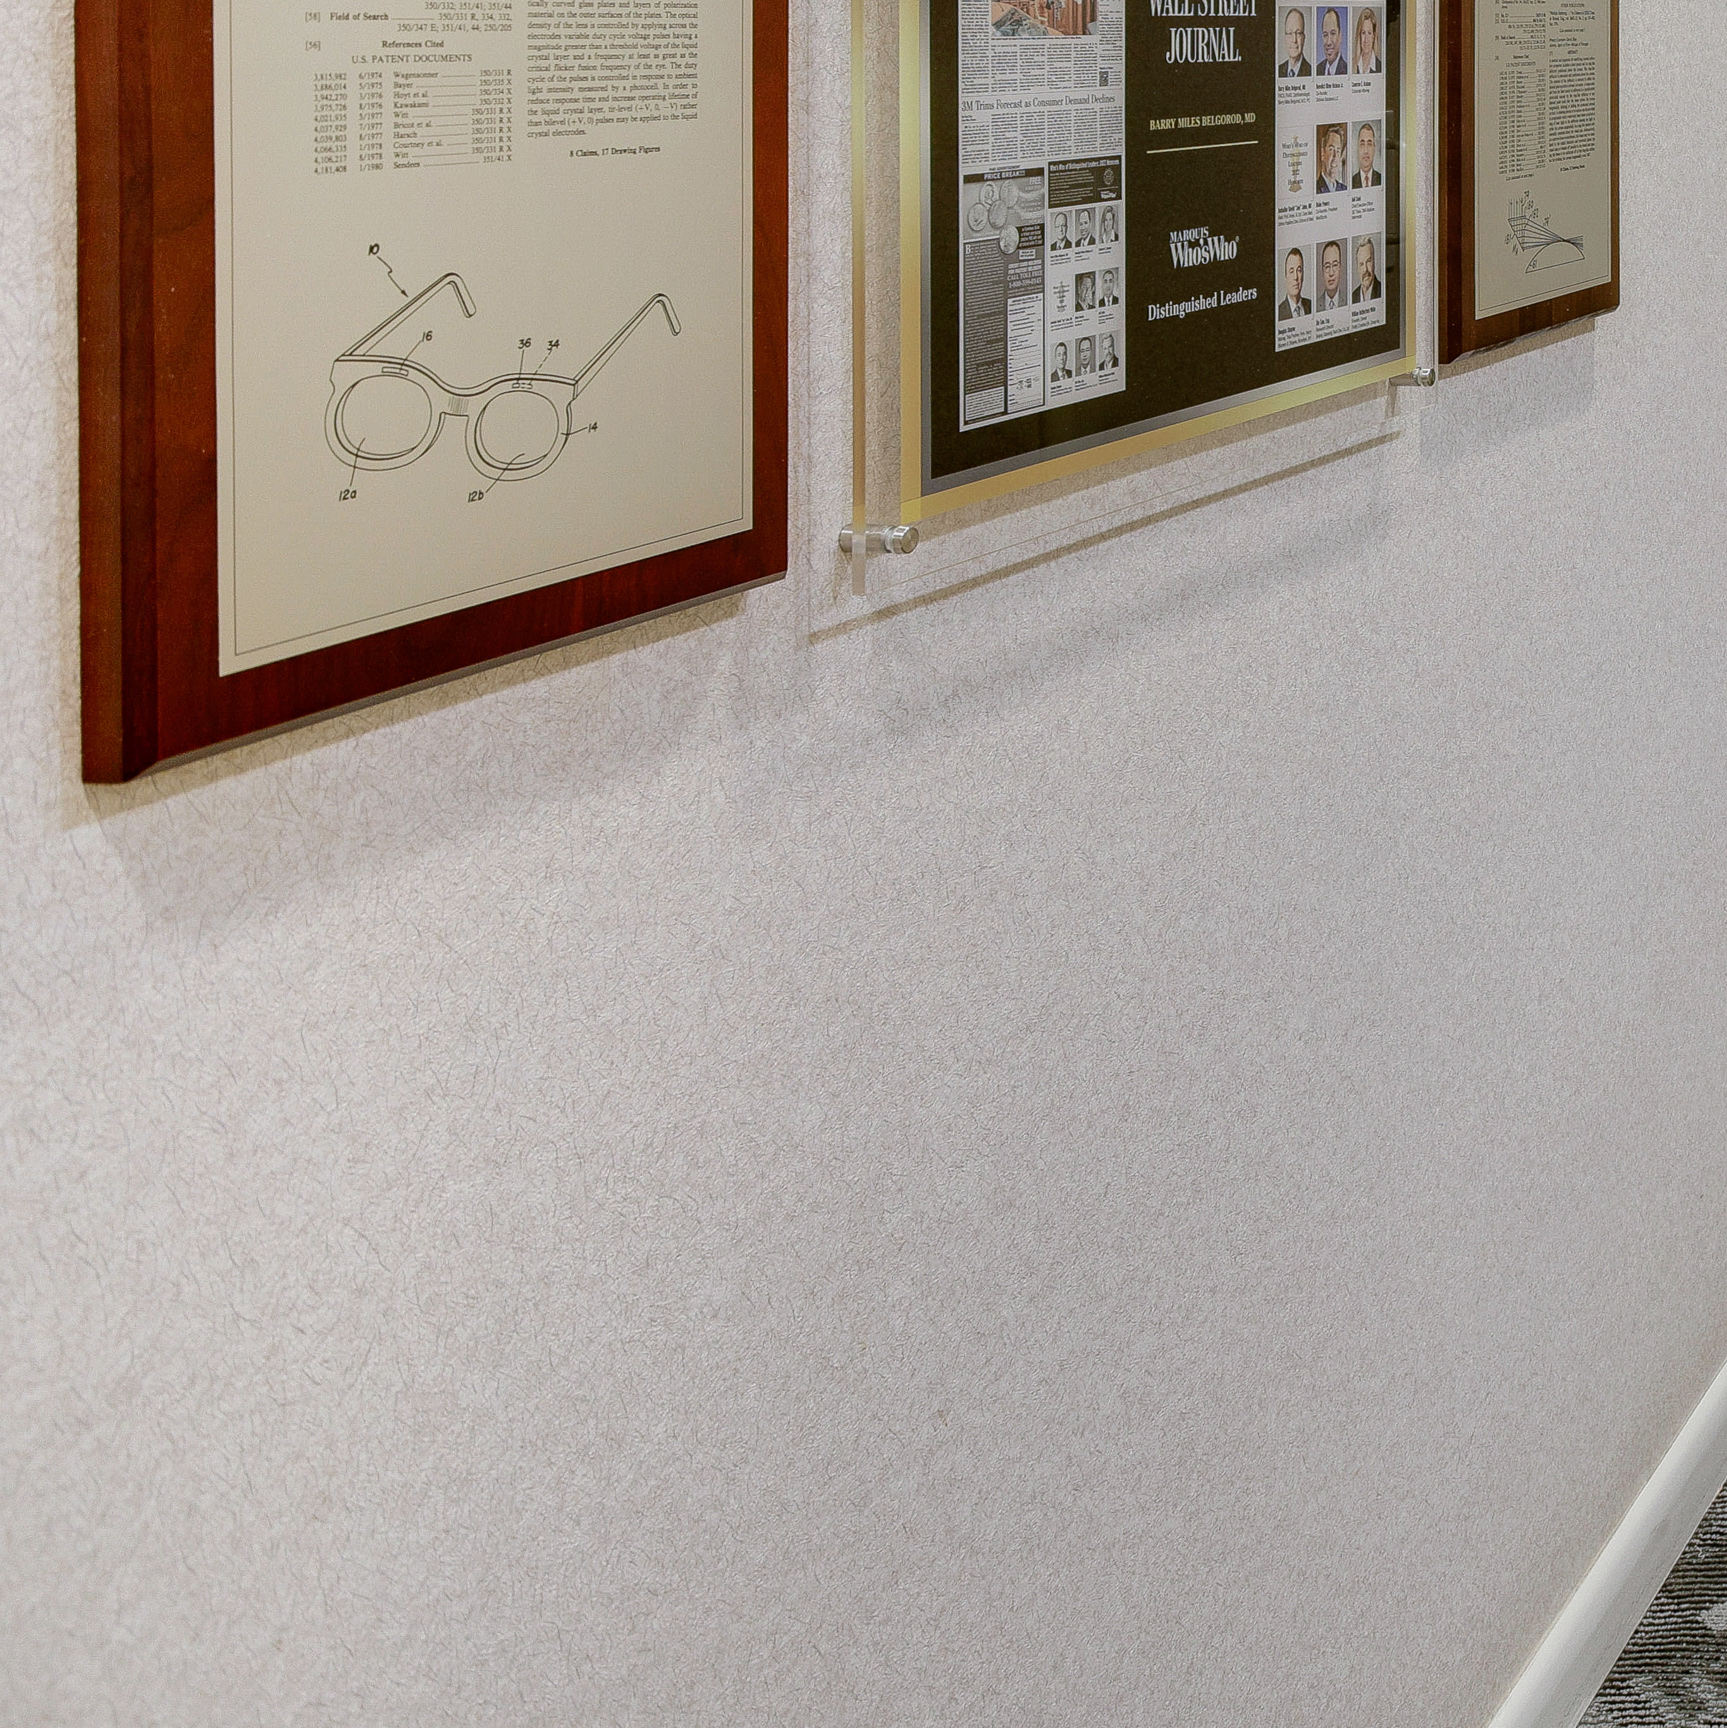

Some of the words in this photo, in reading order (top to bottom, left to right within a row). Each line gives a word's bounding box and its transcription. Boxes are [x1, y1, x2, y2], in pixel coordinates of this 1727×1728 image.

[1165, 27, 1242, 64] JOURNAL.
[961, 101, 974, 112] 3M
[975, 100, 995, 112] Trims
[996, 97, 1023, 110] Forecast
[1024, 99, 1032, 109] as
[1033, 96, 1063, 108] Consumer
[1064, 94, 1090, 106] Demand
[1091, 93, 1116, 105] Declines
[1150, 118, 1176, 131] BARRY
[1177, 116, 1201, 128] MILES
[1202, 113, 1244, 127] BELGOROD,
[1244, 112, 1256, 123] MD
[1169, 226, 1209, 243] MARQUIS
[368, 243, 380, 256] 10
[1148, 292, 1218, 321] Distinguished
[1220, 286, 1257, 306] Leaders
[421, 330, 433, 342] 16
[517, 337, 532, 350] 36
[547, 339, 560, 351] 34
[588, 421, 599, 432] 14
[338, 488, 357, 502] 12a
[467, 490, 484, 503] 12b
